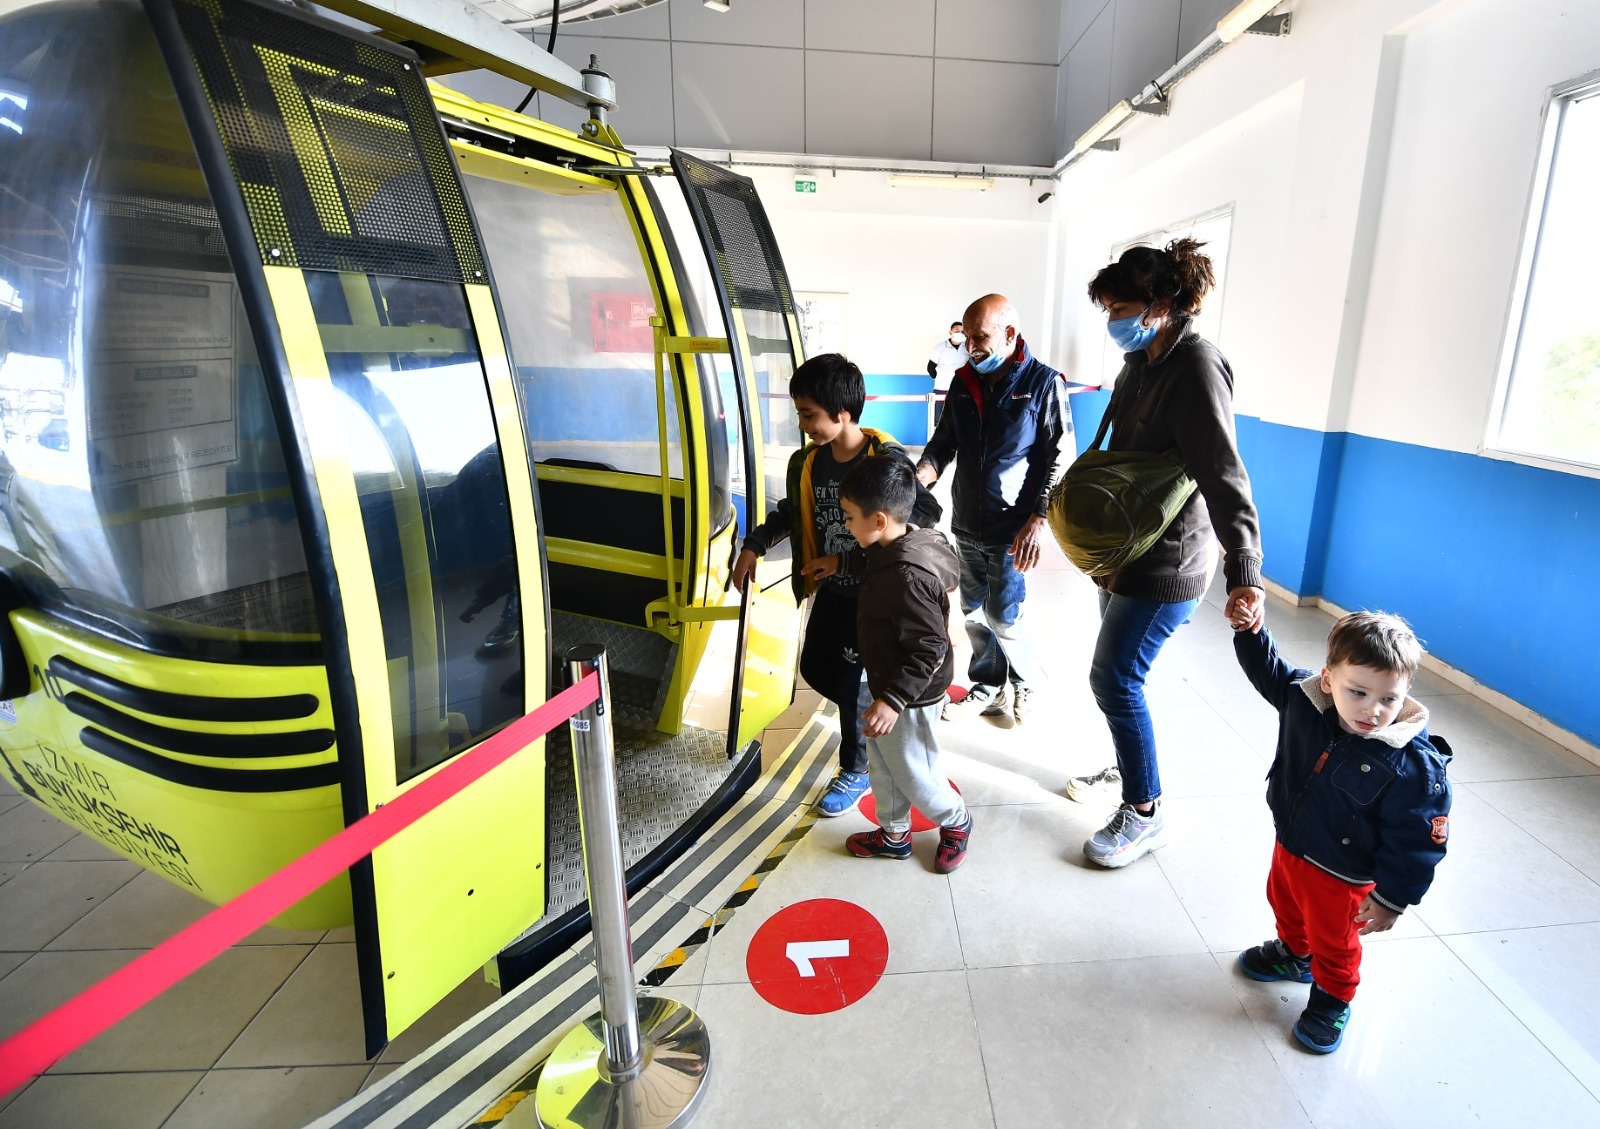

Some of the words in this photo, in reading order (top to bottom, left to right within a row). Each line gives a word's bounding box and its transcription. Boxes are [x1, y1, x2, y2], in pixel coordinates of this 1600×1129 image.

[36, 740, 117, 801] İZMİR
[22, 760, 188, 864] BÜYÜKŞEHİR
[51, 796, 203, 892] BELEDİYESİ
[785, 939, 850, 978] 1
